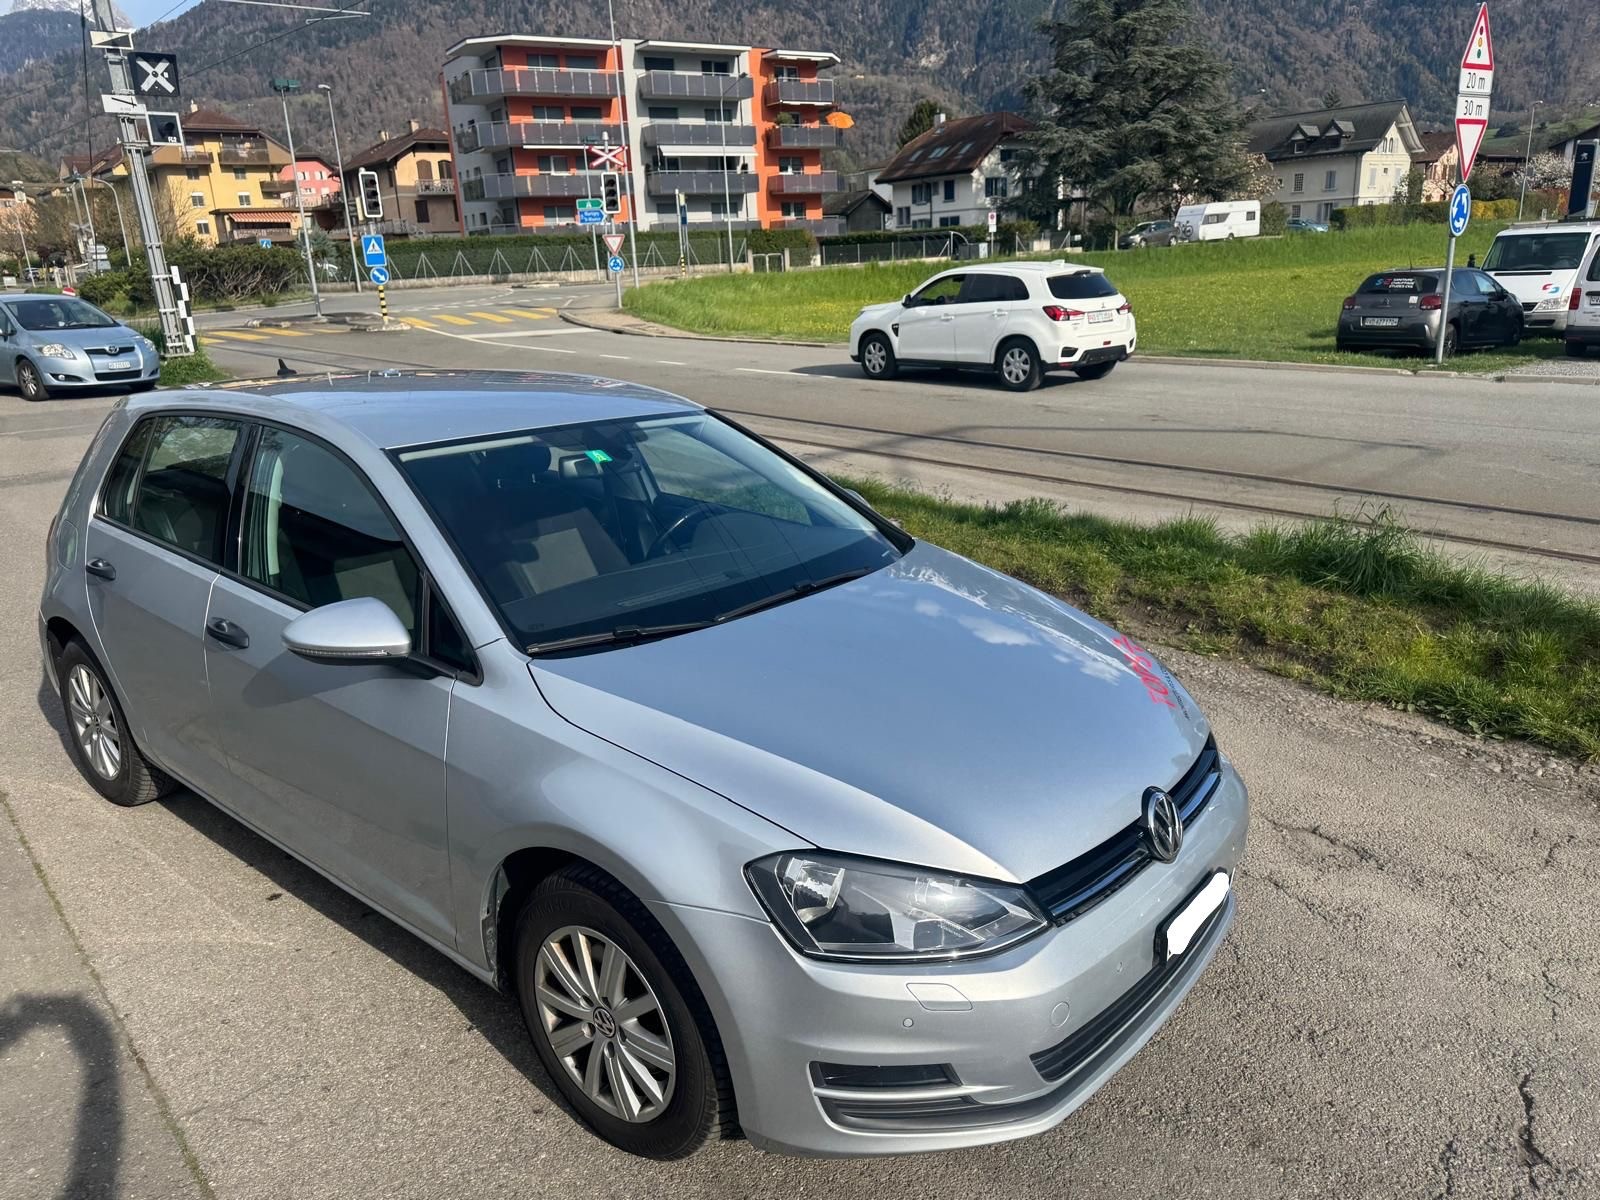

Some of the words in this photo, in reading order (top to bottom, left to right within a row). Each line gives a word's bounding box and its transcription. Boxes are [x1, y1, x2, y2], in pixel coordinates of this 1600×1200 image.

[1466, 72, 1476, 89] 20
[1478, 77, 1486, 90] m
[1463, 99, 1474, 116] 30
[1475, 104, 1483, 116] m
